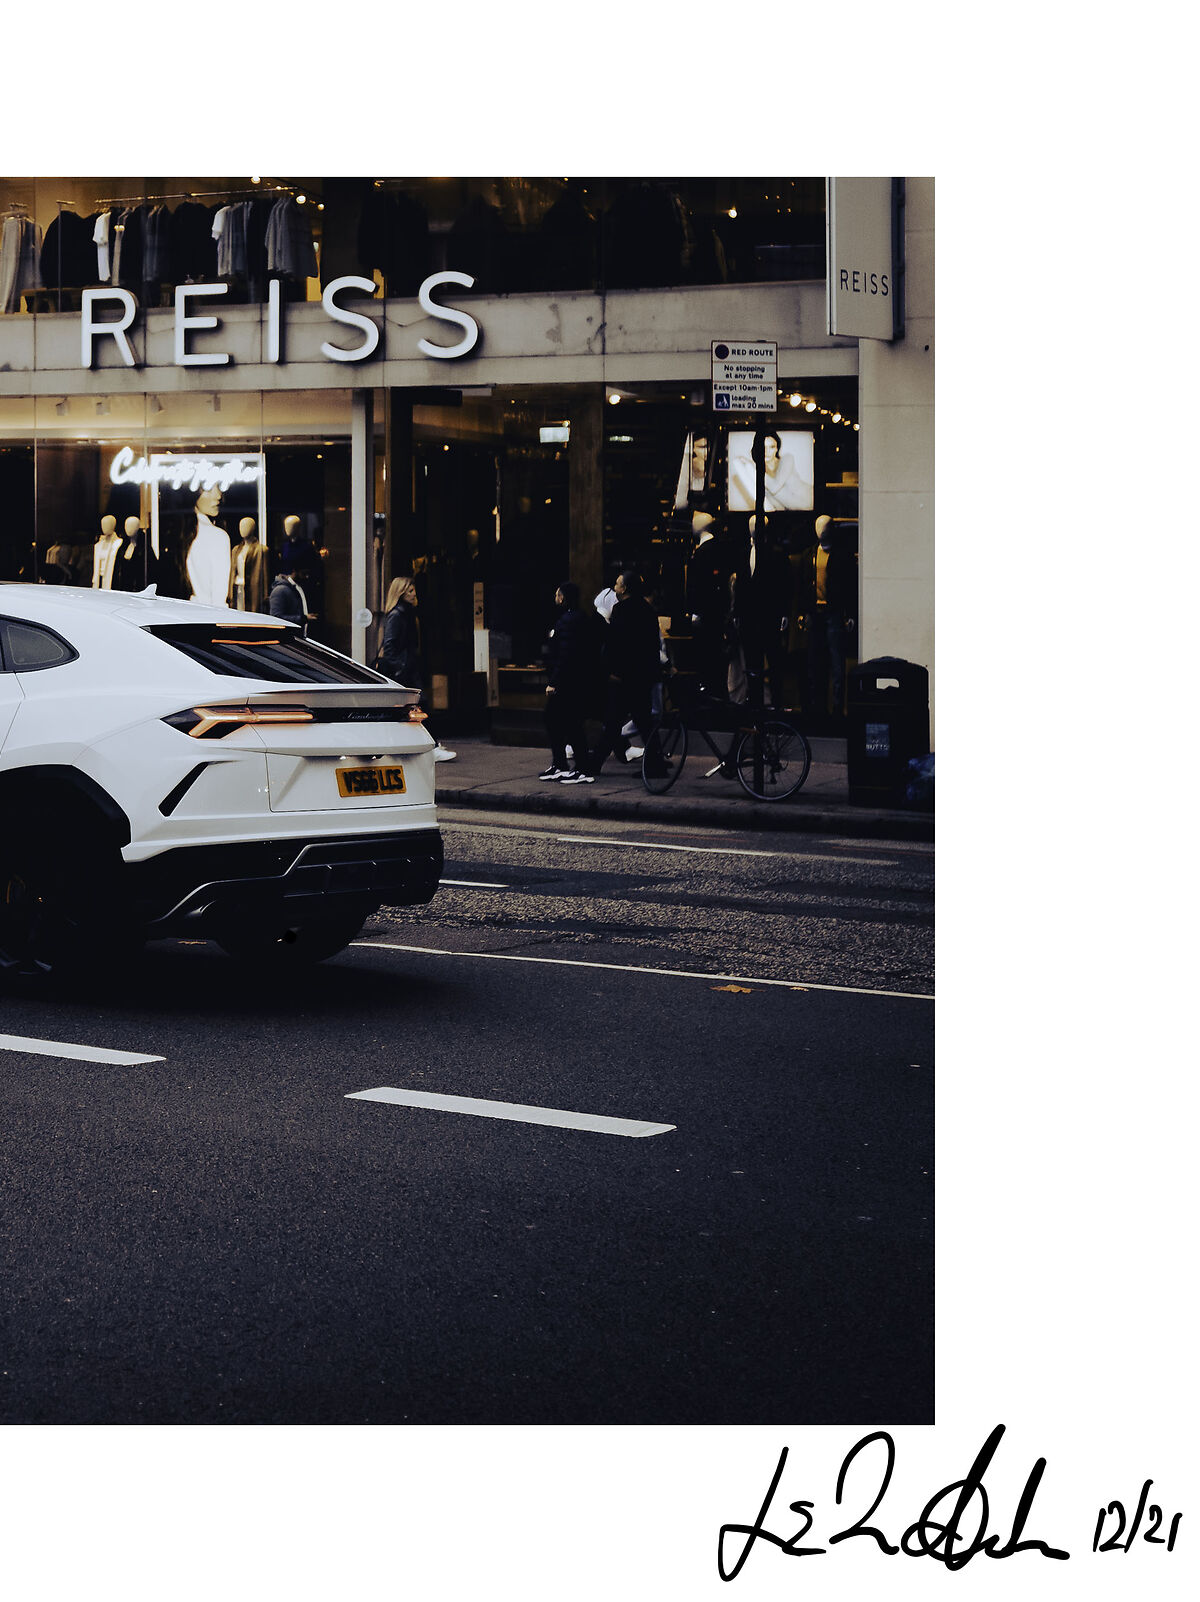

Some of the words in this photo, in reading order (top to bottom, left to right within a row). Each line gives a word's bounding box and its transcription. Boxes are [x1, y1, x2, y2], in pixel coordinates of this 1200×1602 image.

[840, 269, 889, 296] REISS
[81, 271, 479, 368] REISS
[736, 365, 765, 373] stopping
